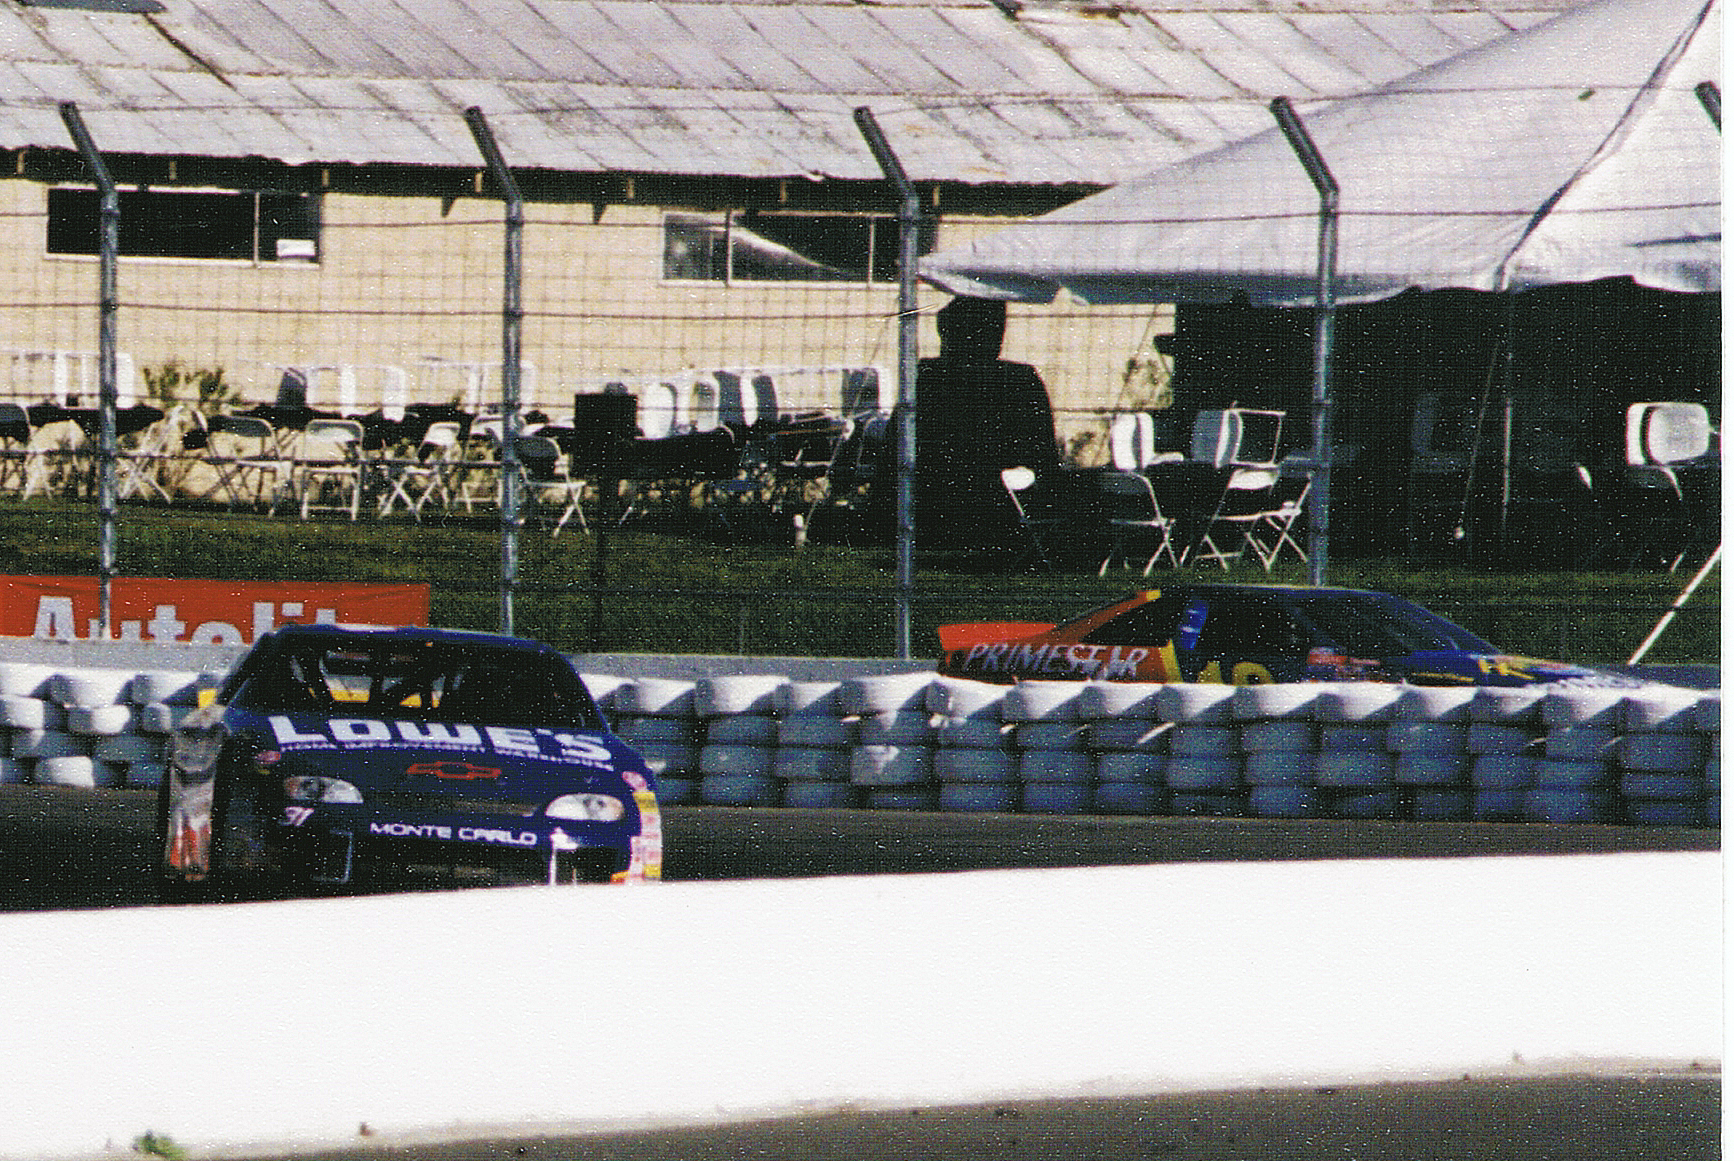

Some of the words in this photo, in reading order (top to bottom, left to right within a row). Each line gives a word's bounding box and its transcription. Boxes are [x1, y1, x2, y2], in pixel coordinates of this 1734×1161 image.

[268, 714, 612, 761] LOWE'S
[370, 822, 453, 840] MONTE
[458, 827, 538, 847] CARLO
